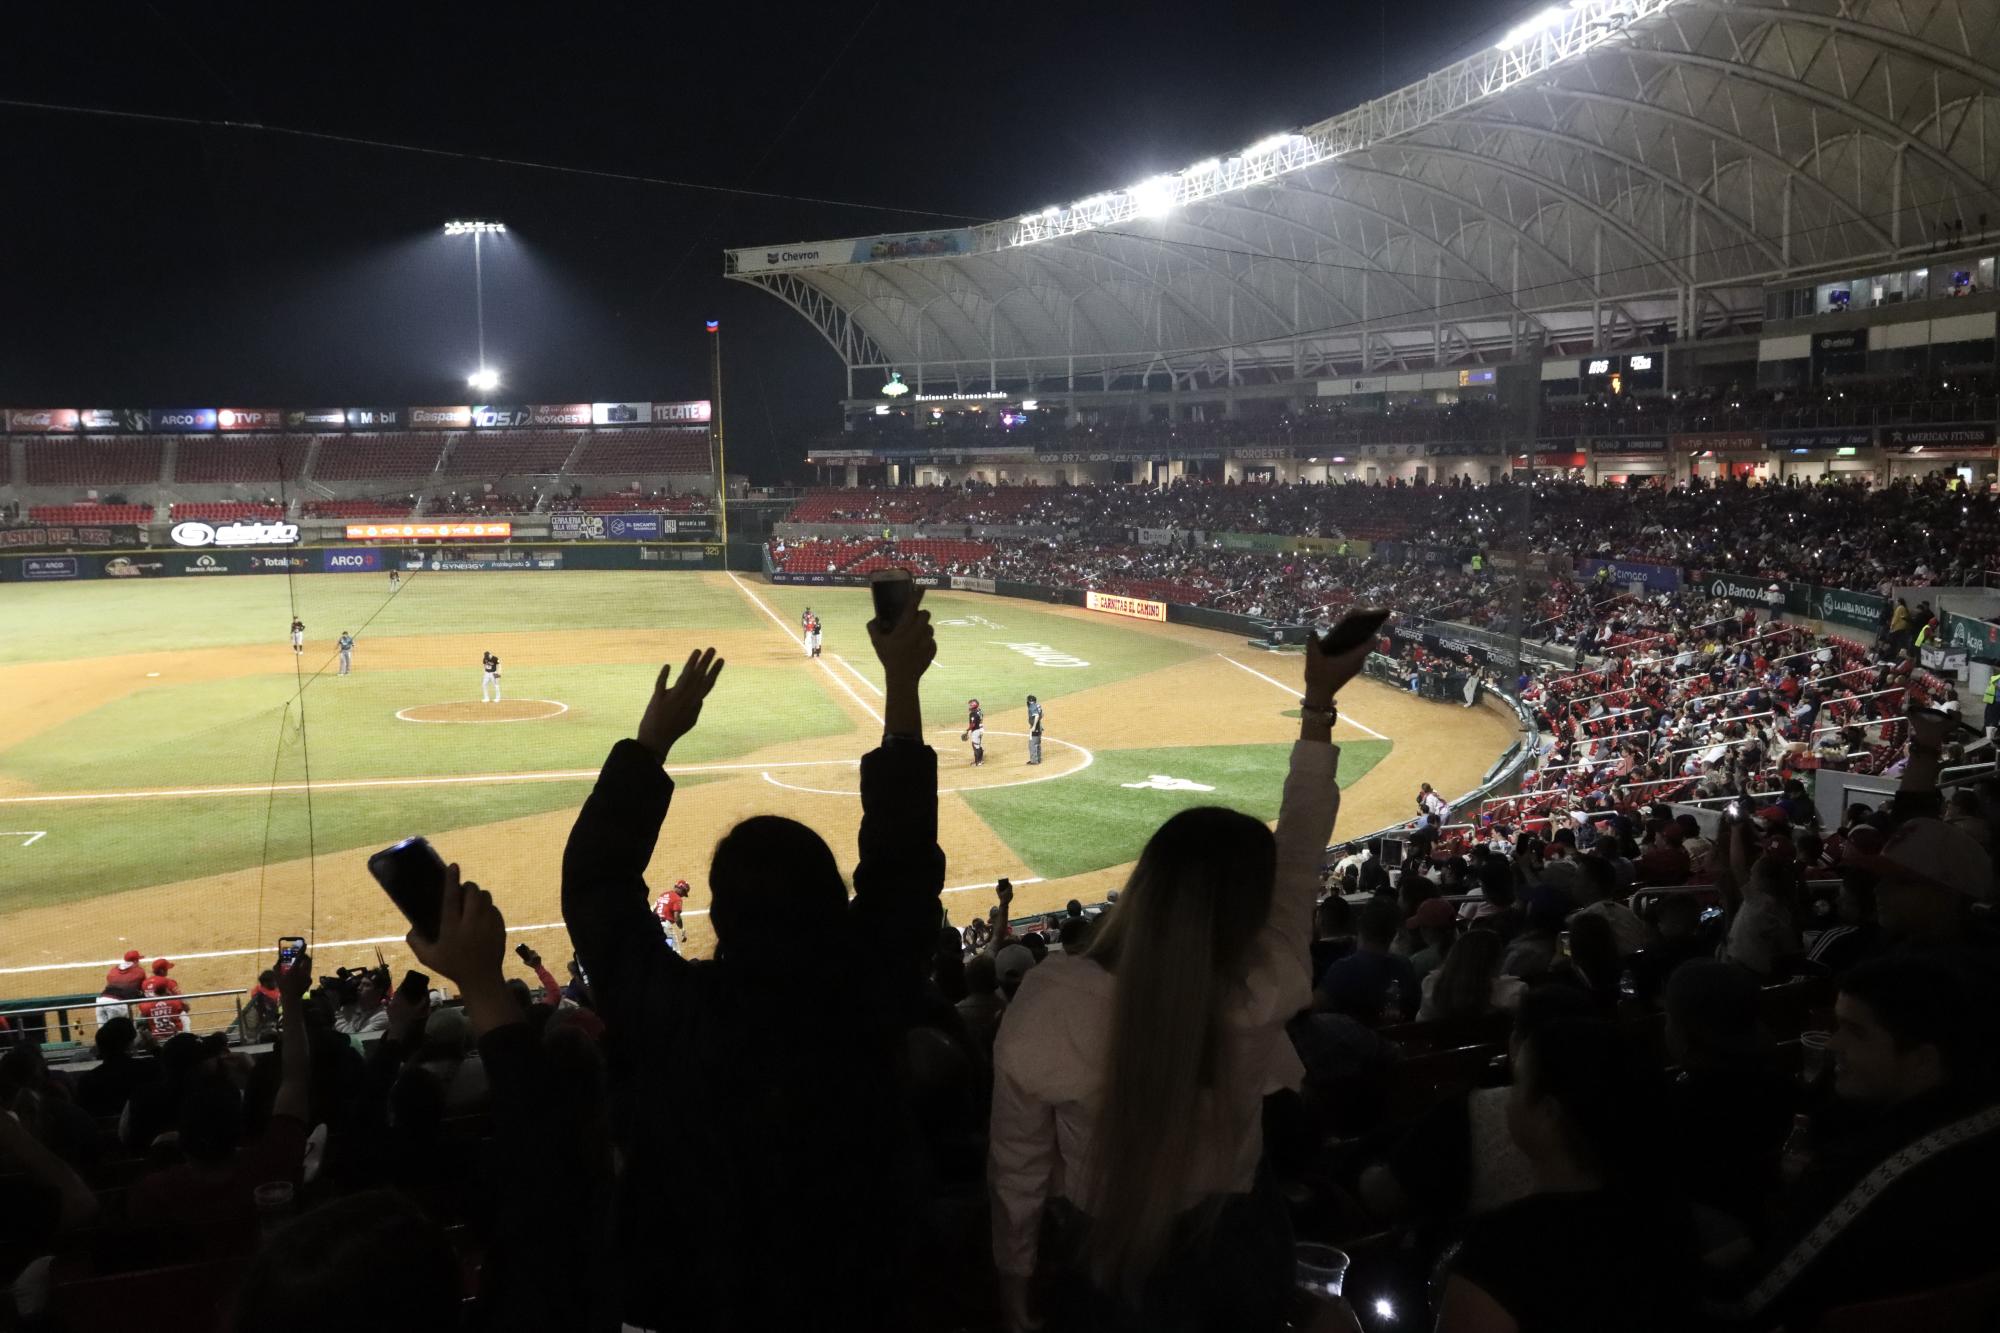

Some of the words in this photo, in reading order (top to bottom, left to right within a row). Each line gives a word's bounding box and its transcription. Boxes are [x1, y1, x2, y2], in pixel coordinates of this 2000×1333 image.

[782, 251, 819, 262] Chevron
[234, 412, 261, 423] TVP
[361, 411, 396, 424] Mobil
[654, 405, 700, 420] TECATE
[161, 415, 193, 425] ARCO
[1906, 431, 1948, 441] AMERICAN
[1950, 430, 1985, 440] FITNESS
[331, 557, 363, 567] ARCO
[1728, 583, 1756, 599] Banco
[1101, 597, 1128, 612] CARNITAS
[1128, 601, 1136, 613] EL
[1136, 602, 1160, 617] CAMINO
[1395, 627, 1424, 642] POWERADE
[1439, 638, 1469, 654] POWERADE
